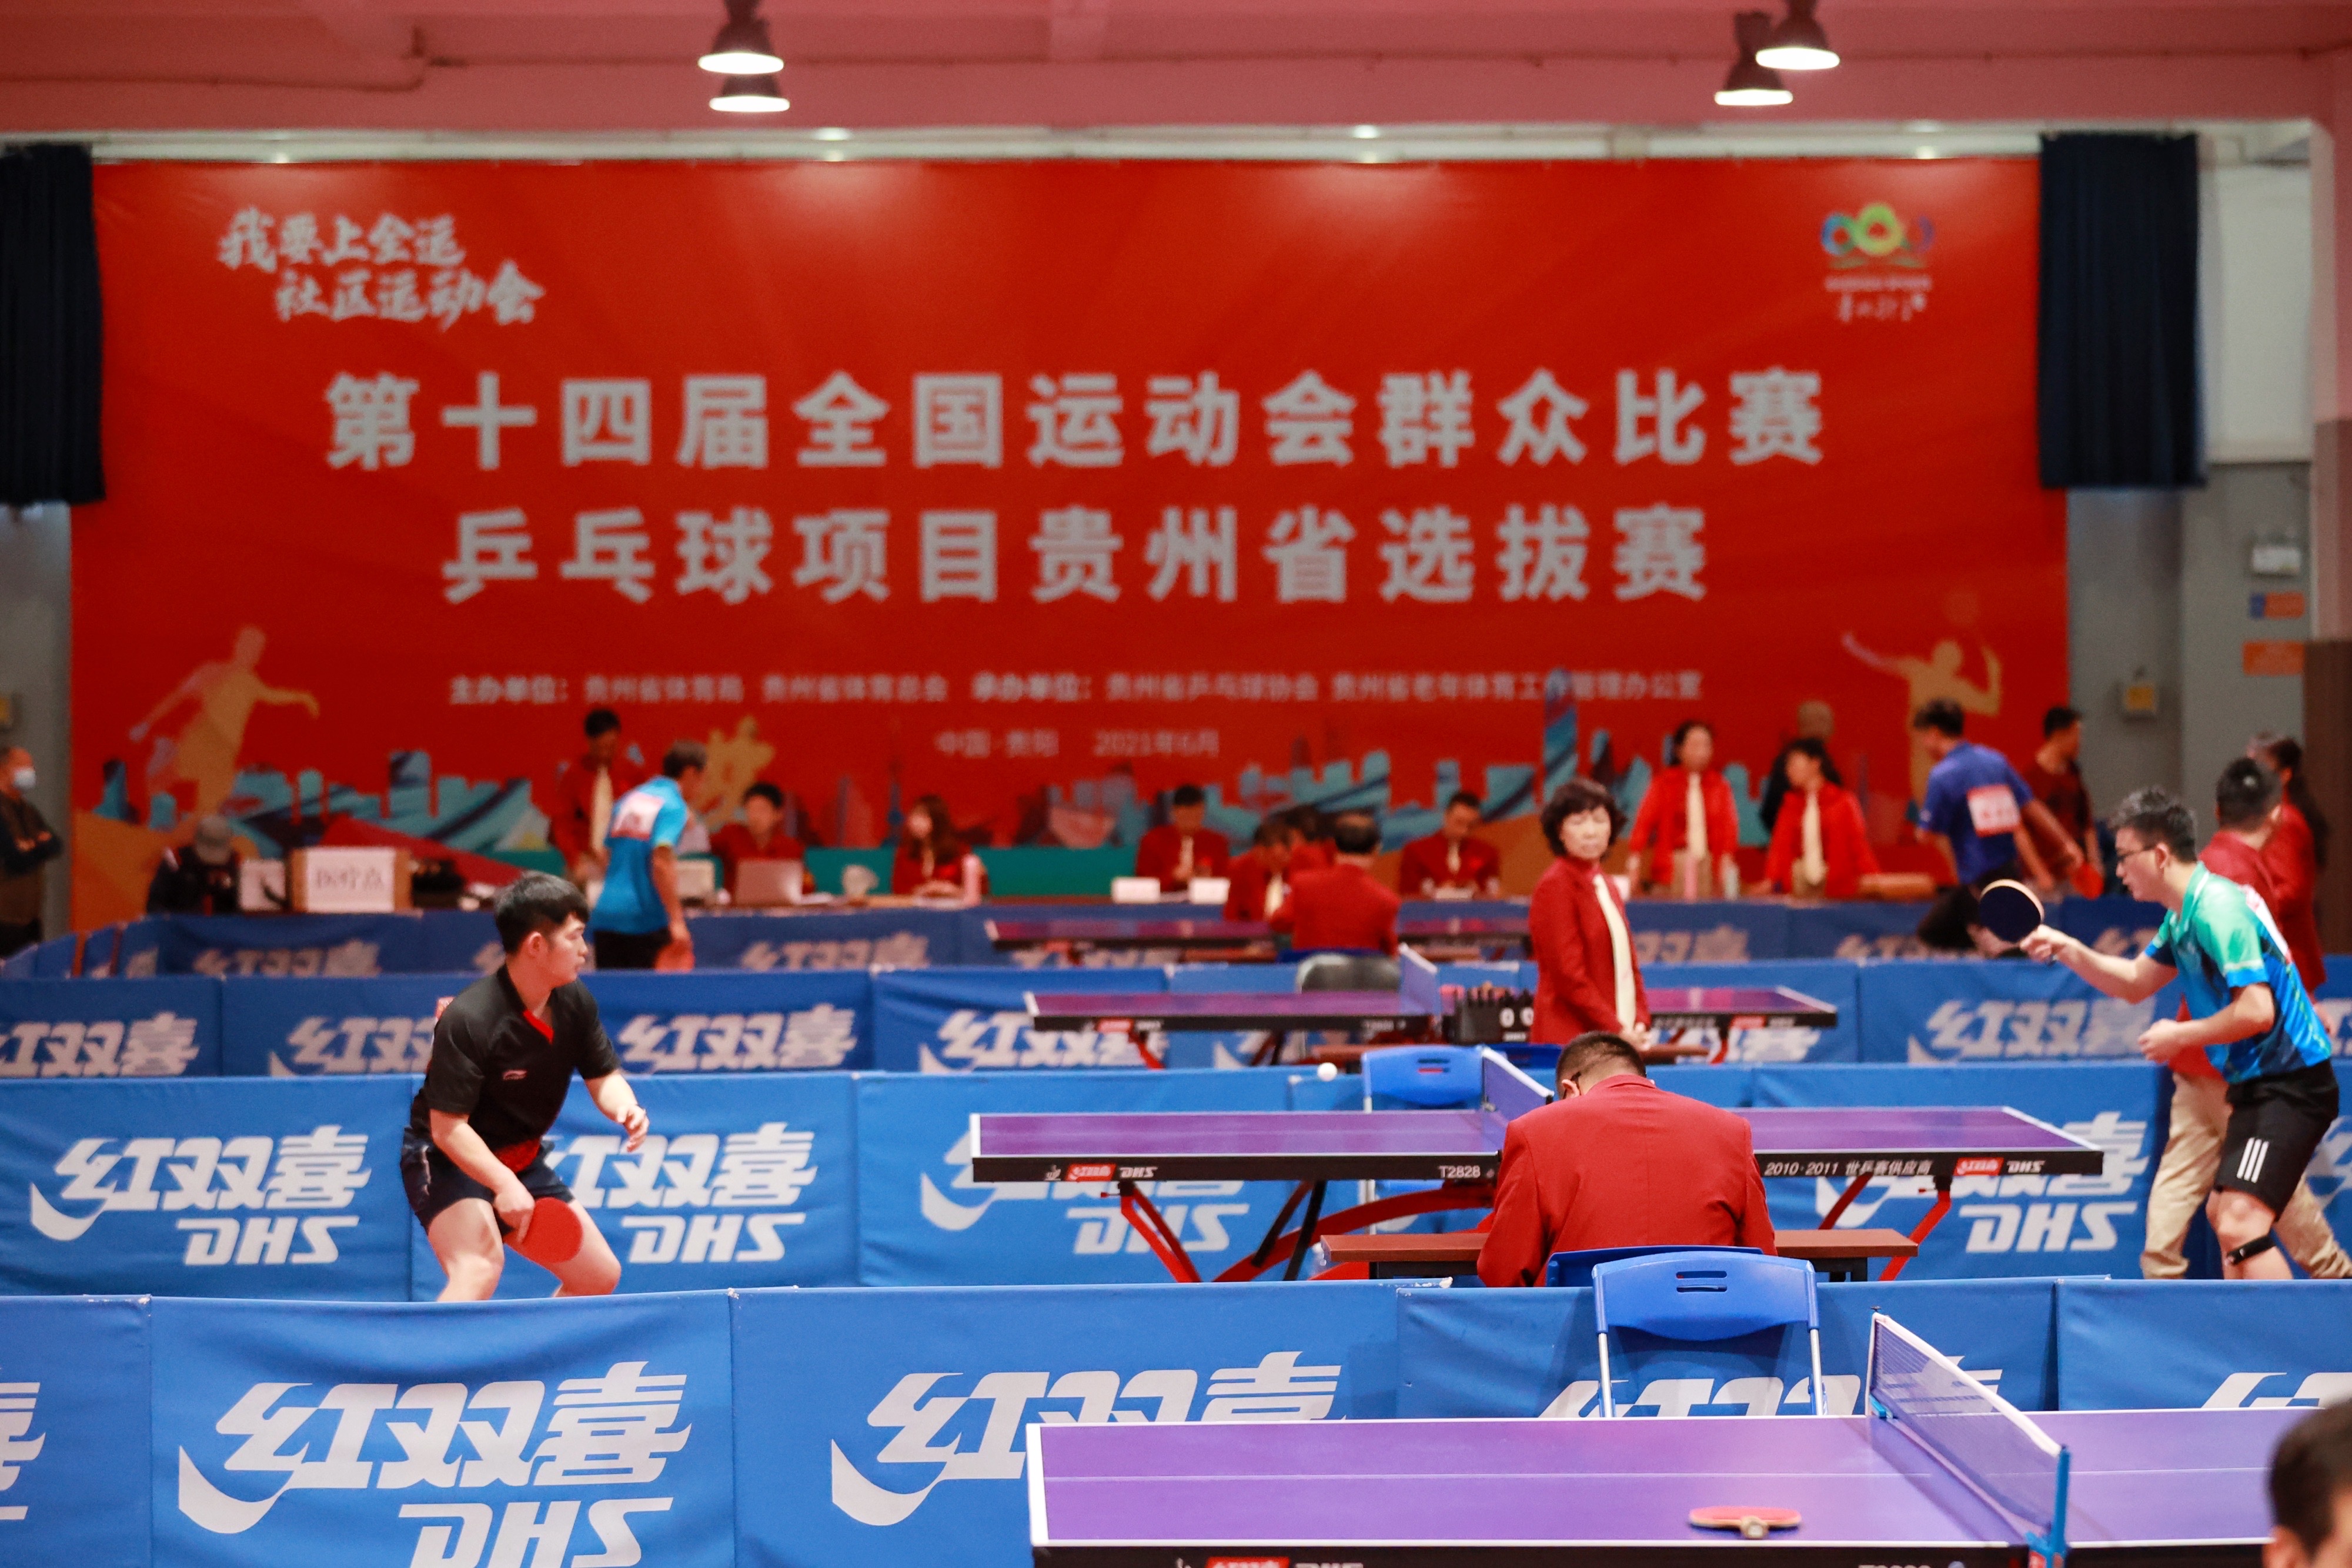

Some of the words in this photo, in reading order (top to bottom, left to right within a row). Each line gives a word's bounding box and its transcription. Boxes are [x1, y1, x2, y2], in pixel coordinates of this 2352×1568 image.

[218, 206, 466, 272] 我要上全运
[275, 259, 544, 330] 社区运动会
[325, 367, 1822, 470] 第十四届全国运动会群众比赛
[442, 503, 1706, 604] 乒乓球项目贵州省选拔赛
[613, 1002, 858, 1076] 红双喜
[30, 1125, 372, 1241] 红双喜
[1438, 1165, 1481, 1179] T2828
[176, 1215, 359, 1266] DHS
[620, 1212, 806, 1263] DHS
[1959, 1201, 2137, 1253] DHS
[178, 1361, 692, 1534] 红双喜
[398, 1497, 674, 1568] DHS
